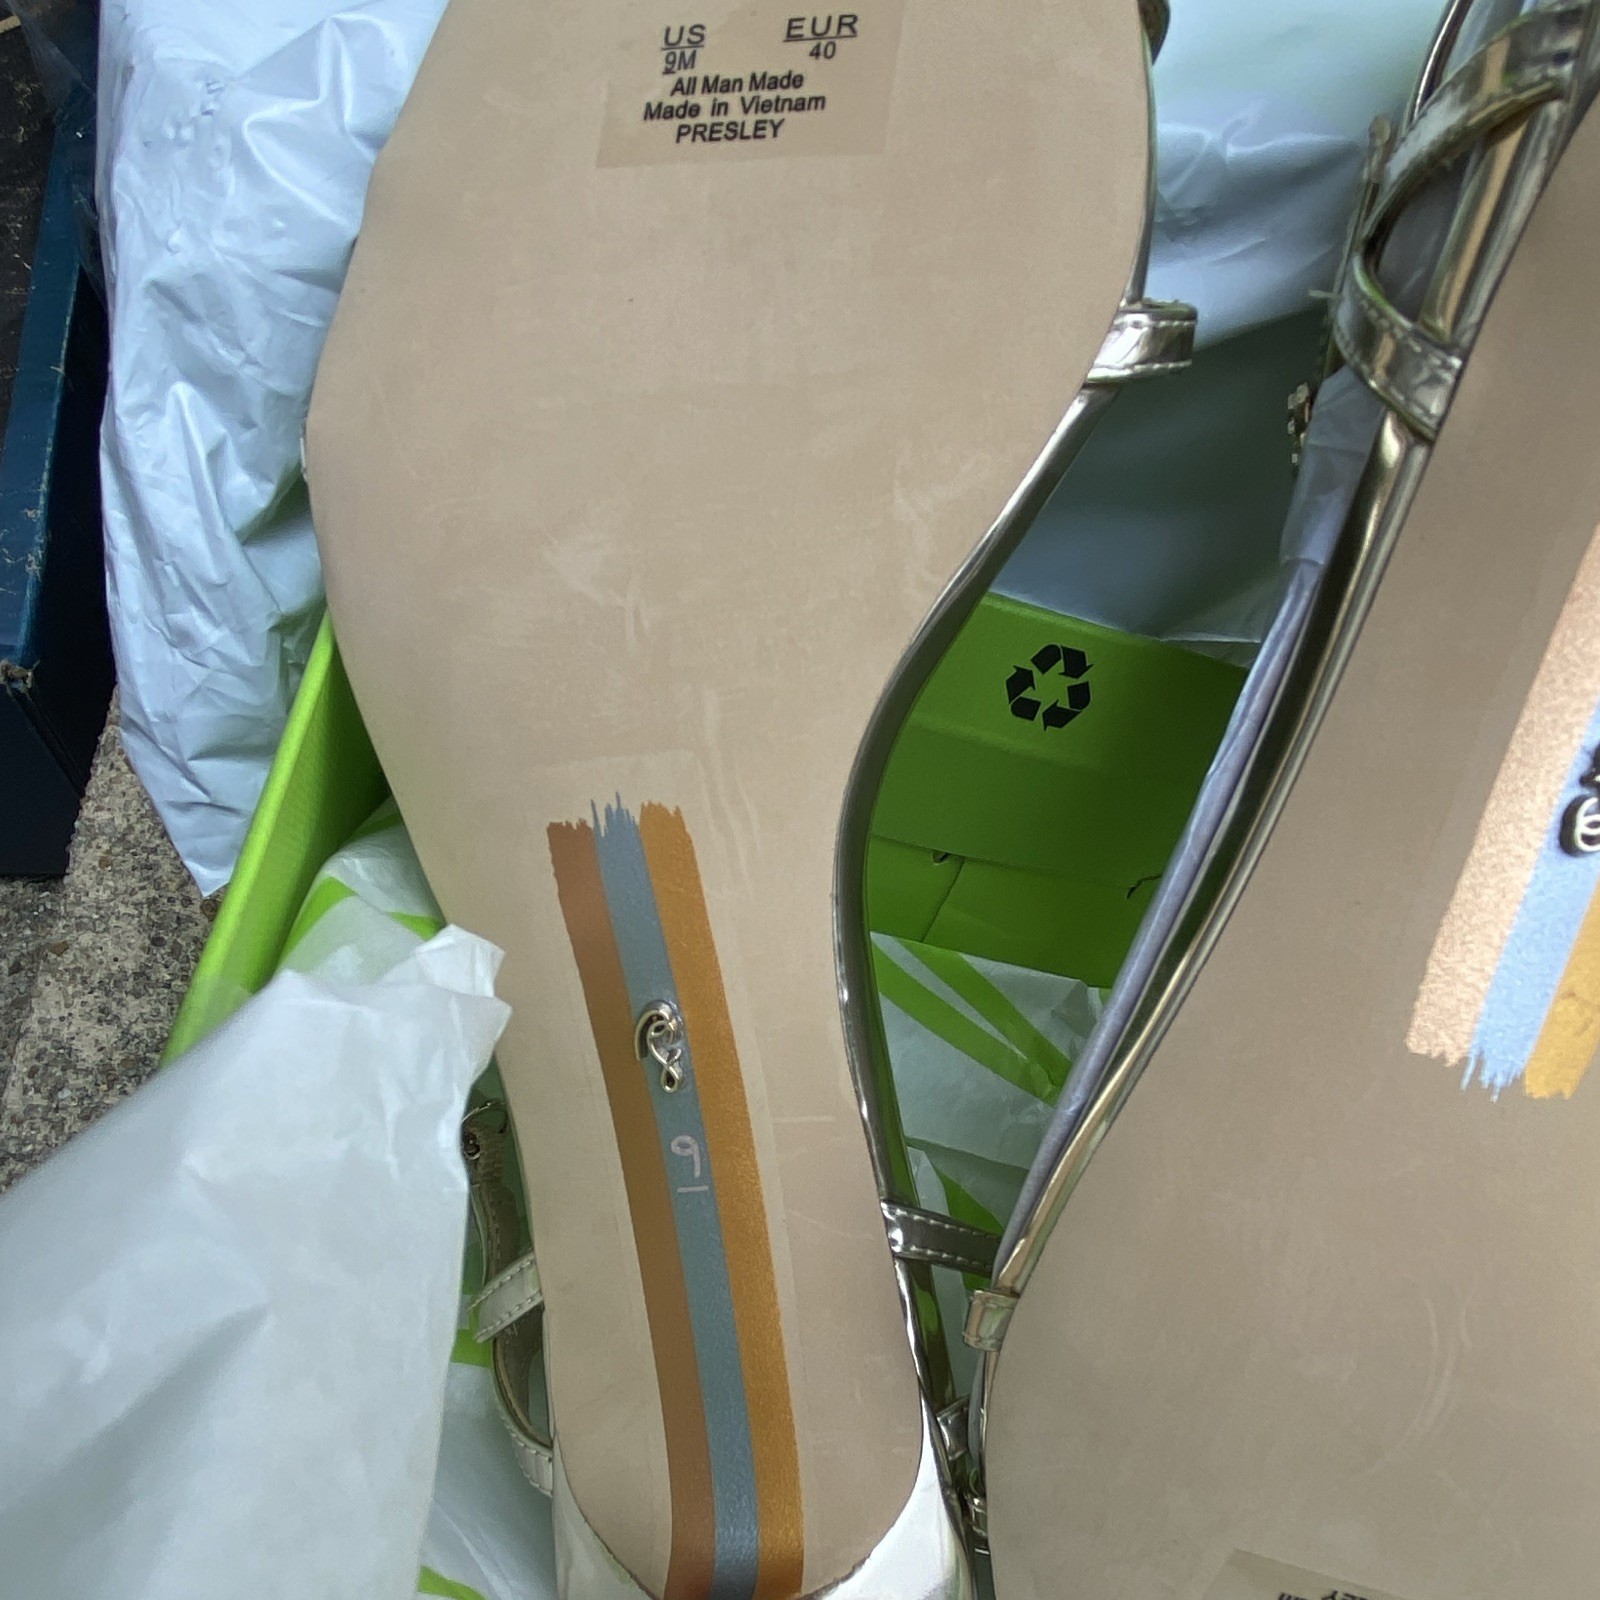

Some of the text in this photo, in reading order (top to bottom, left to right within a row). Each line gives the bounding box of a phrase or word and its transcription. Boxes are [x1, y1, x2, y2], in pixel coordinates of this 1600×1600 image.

[663, 24, 706, 47] US
[785, 14, 859, 40] EUR
[808, 41, 837, 60] 40
[670, 70, 805, 97] All Man Made
[643, 94, 827, 121] Made in Vietnam
[675, 119, 786, 144] PRESLEY
